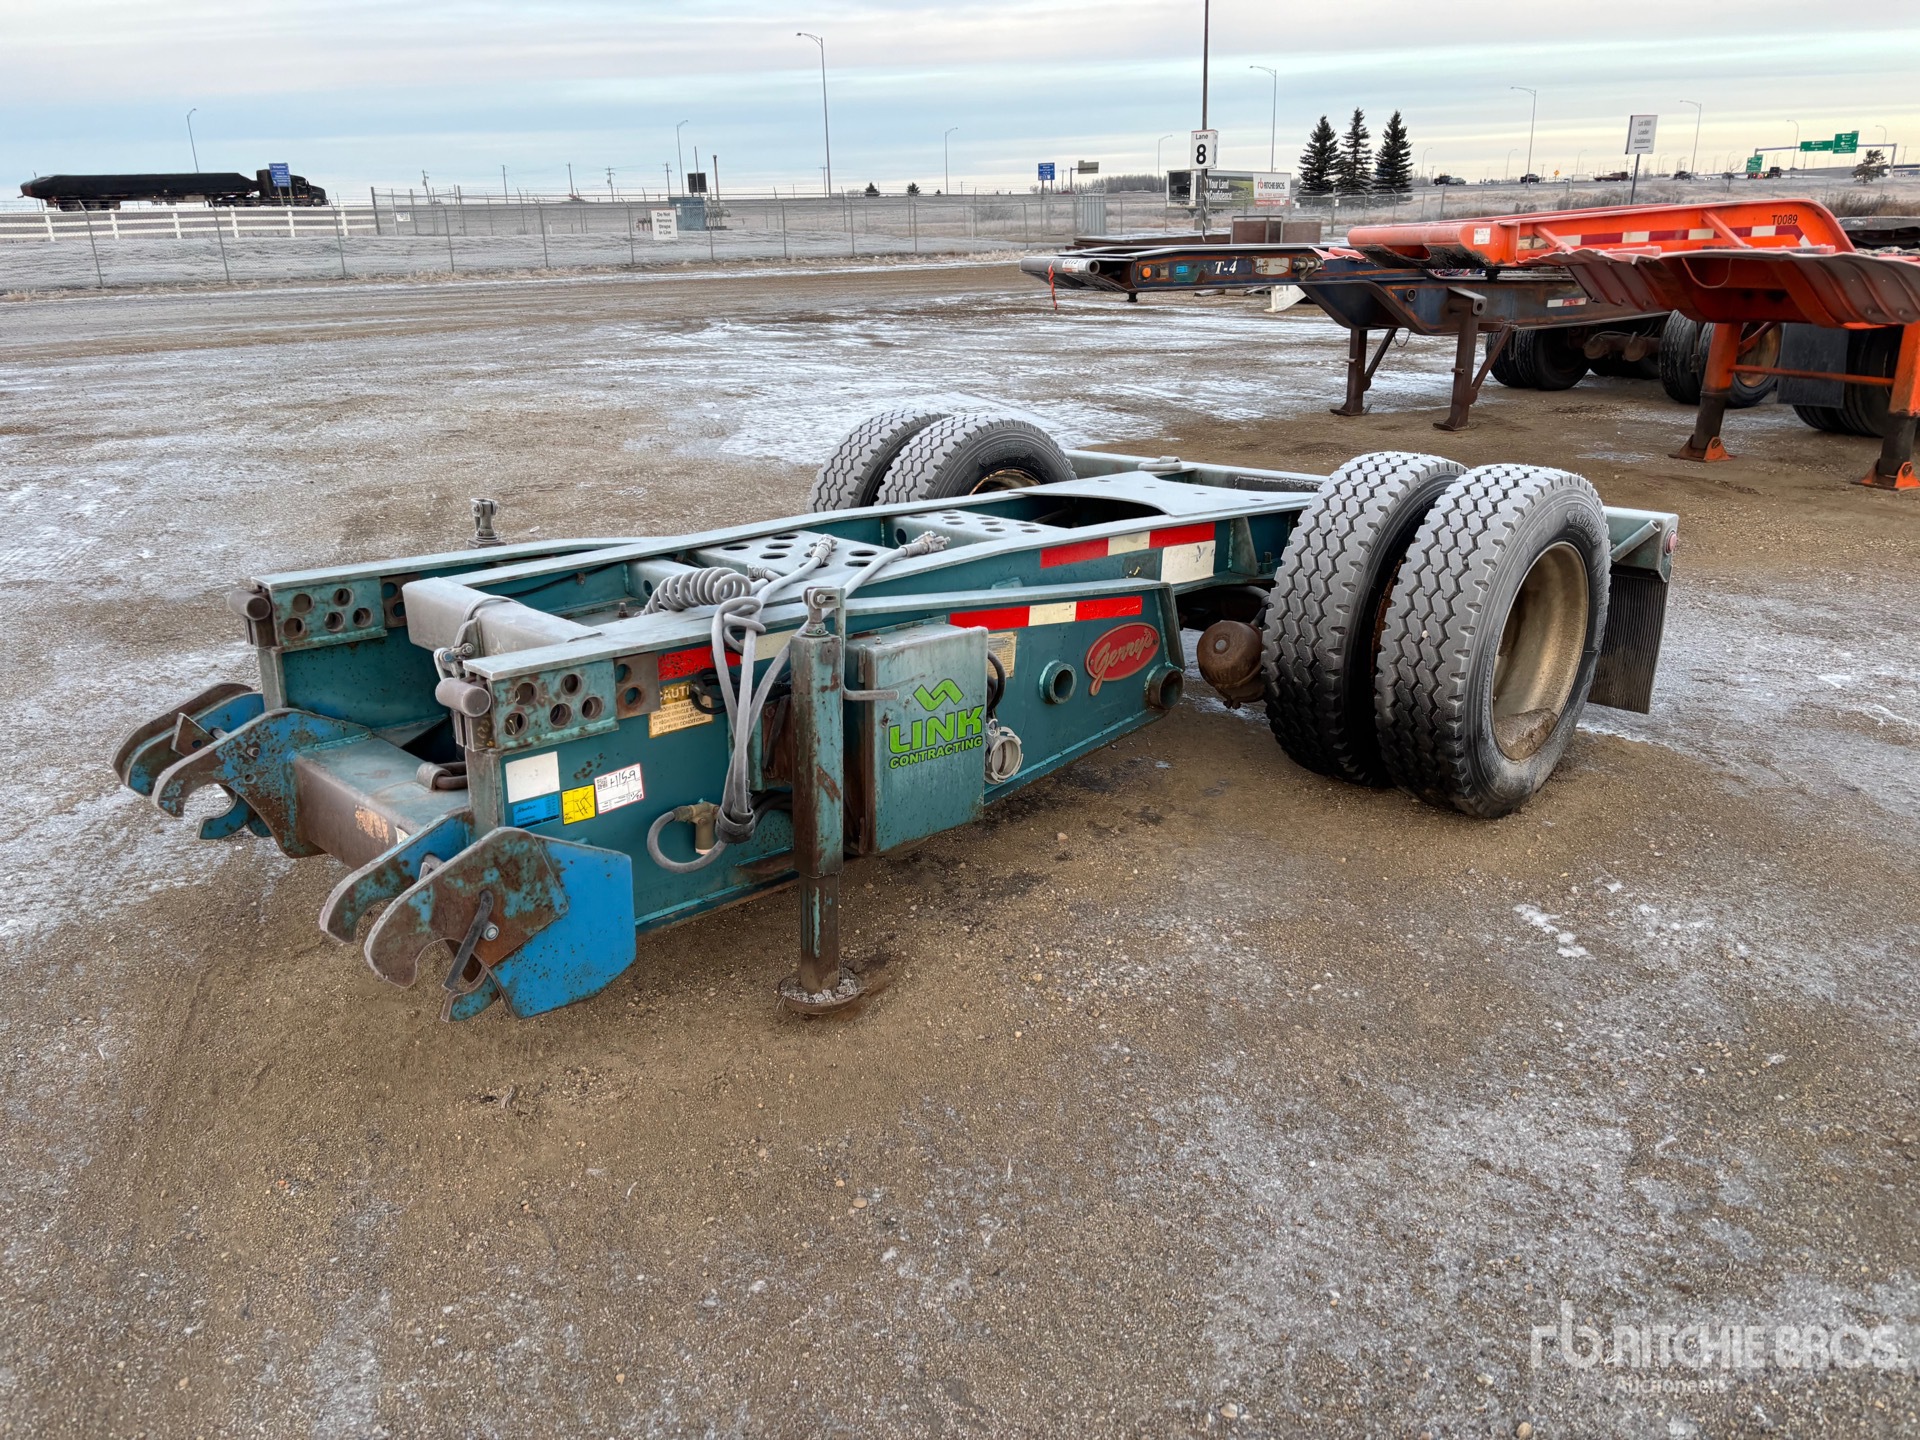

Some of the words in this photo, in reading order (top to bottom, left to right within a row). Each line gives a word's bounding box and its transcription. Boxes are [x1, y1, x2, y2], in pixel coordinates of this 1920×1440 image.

[1196, 143, 1207, 165] 8
[1771, 213, 1798, 225] T0089
[1215, 260, 1238, 275] T-4
[889, 704, 985, 754] LINK
[889, 735, 983, 769] CONTRACTING
